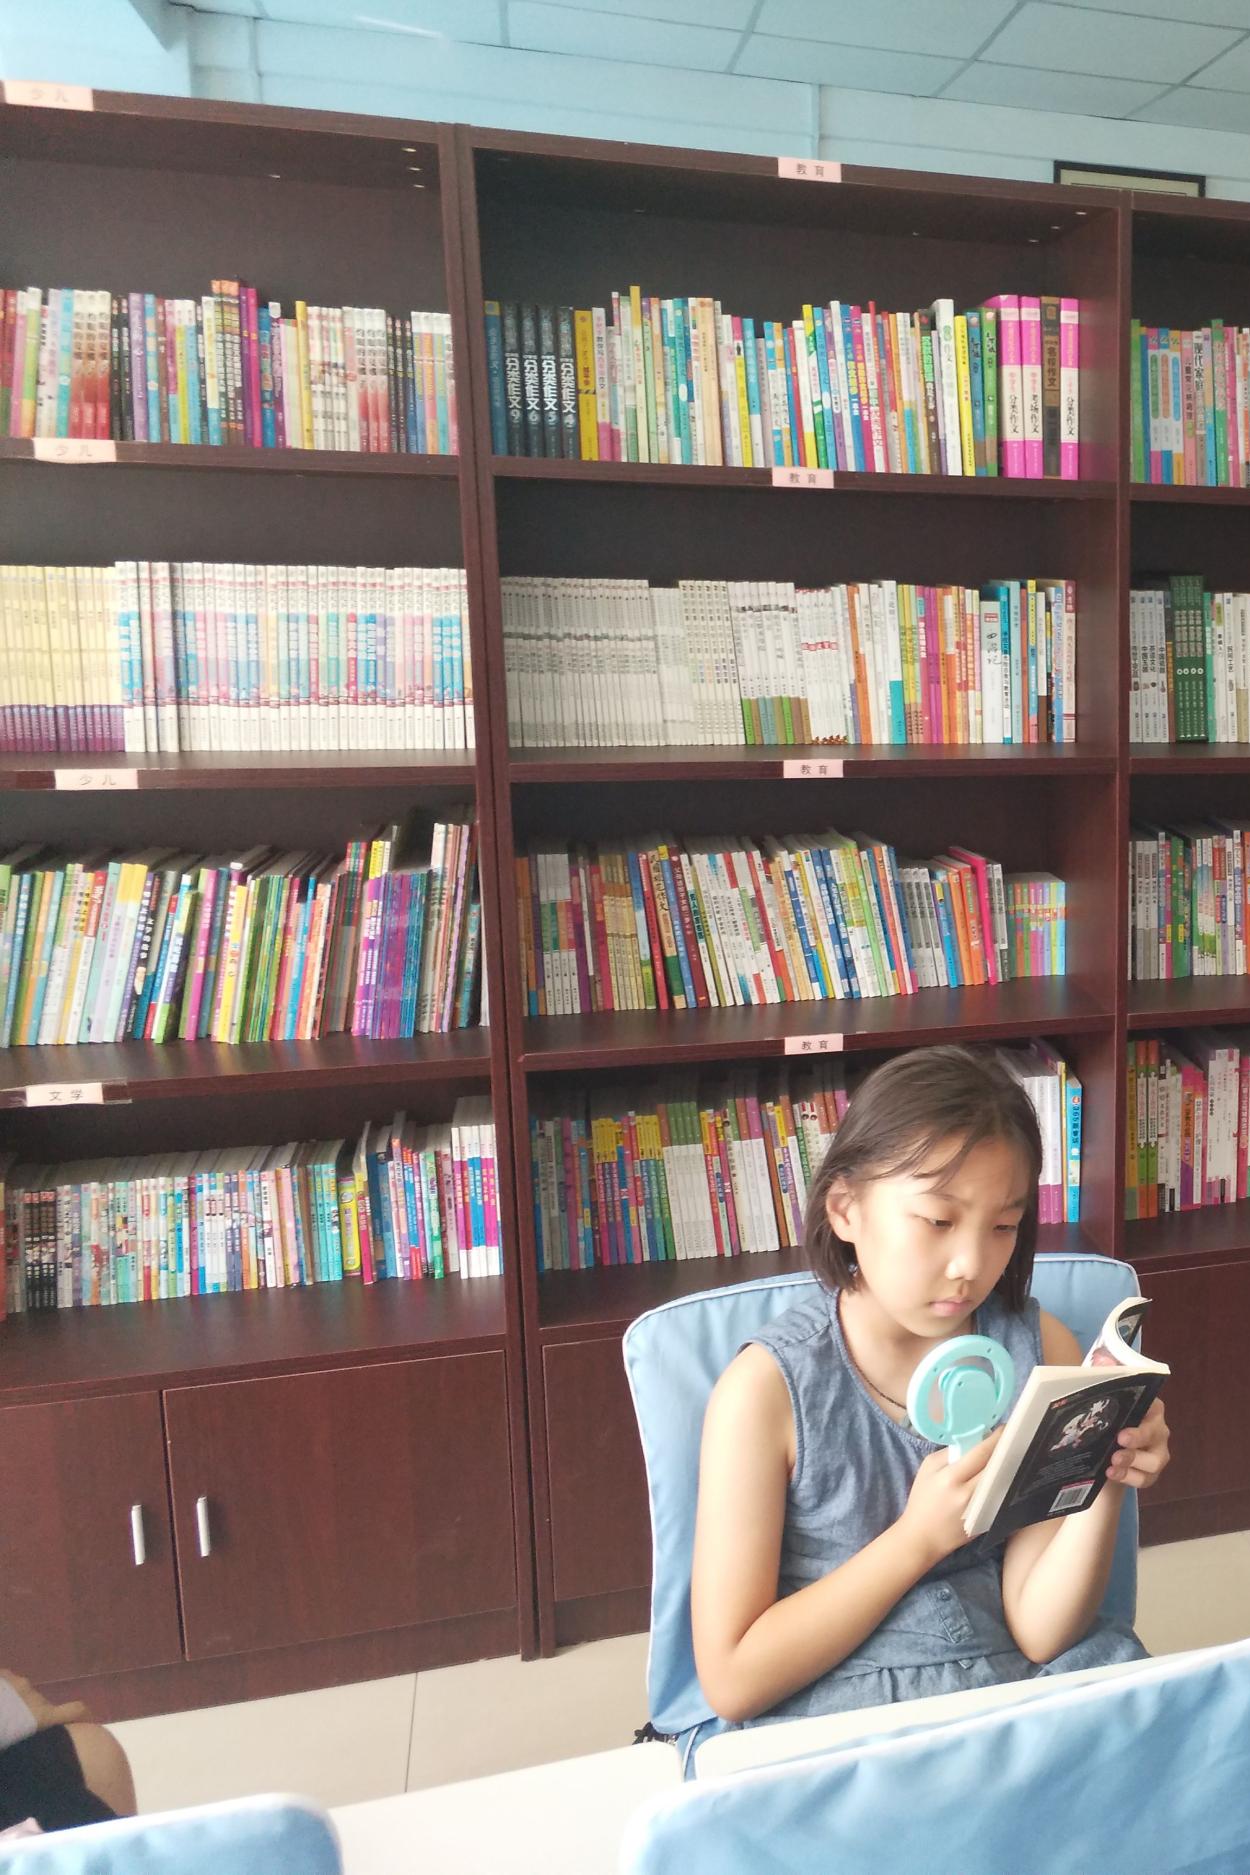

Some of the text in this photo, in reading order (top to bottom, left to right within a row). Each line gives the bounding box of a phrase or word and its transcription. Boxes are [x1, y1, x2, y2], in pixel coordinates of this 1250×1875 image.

[796, 164, 824, 177] 教育
[506, 358, 521, 408] 分类作文
[524, 359, 540, 410] 分类作文
[542, 359, 558, 410] 分类作文
[561, 362, 576, 413] 分类作文
[55, 442, 93, 457] 少儿
[789, 473, 817, 484] 教育
[800, 764, 828, 776] 教育
[79, 774, 116, 786] 少儿
[801, 1039, 828, 1051] 教育
[48, 1089, 83, 1102] 文学
